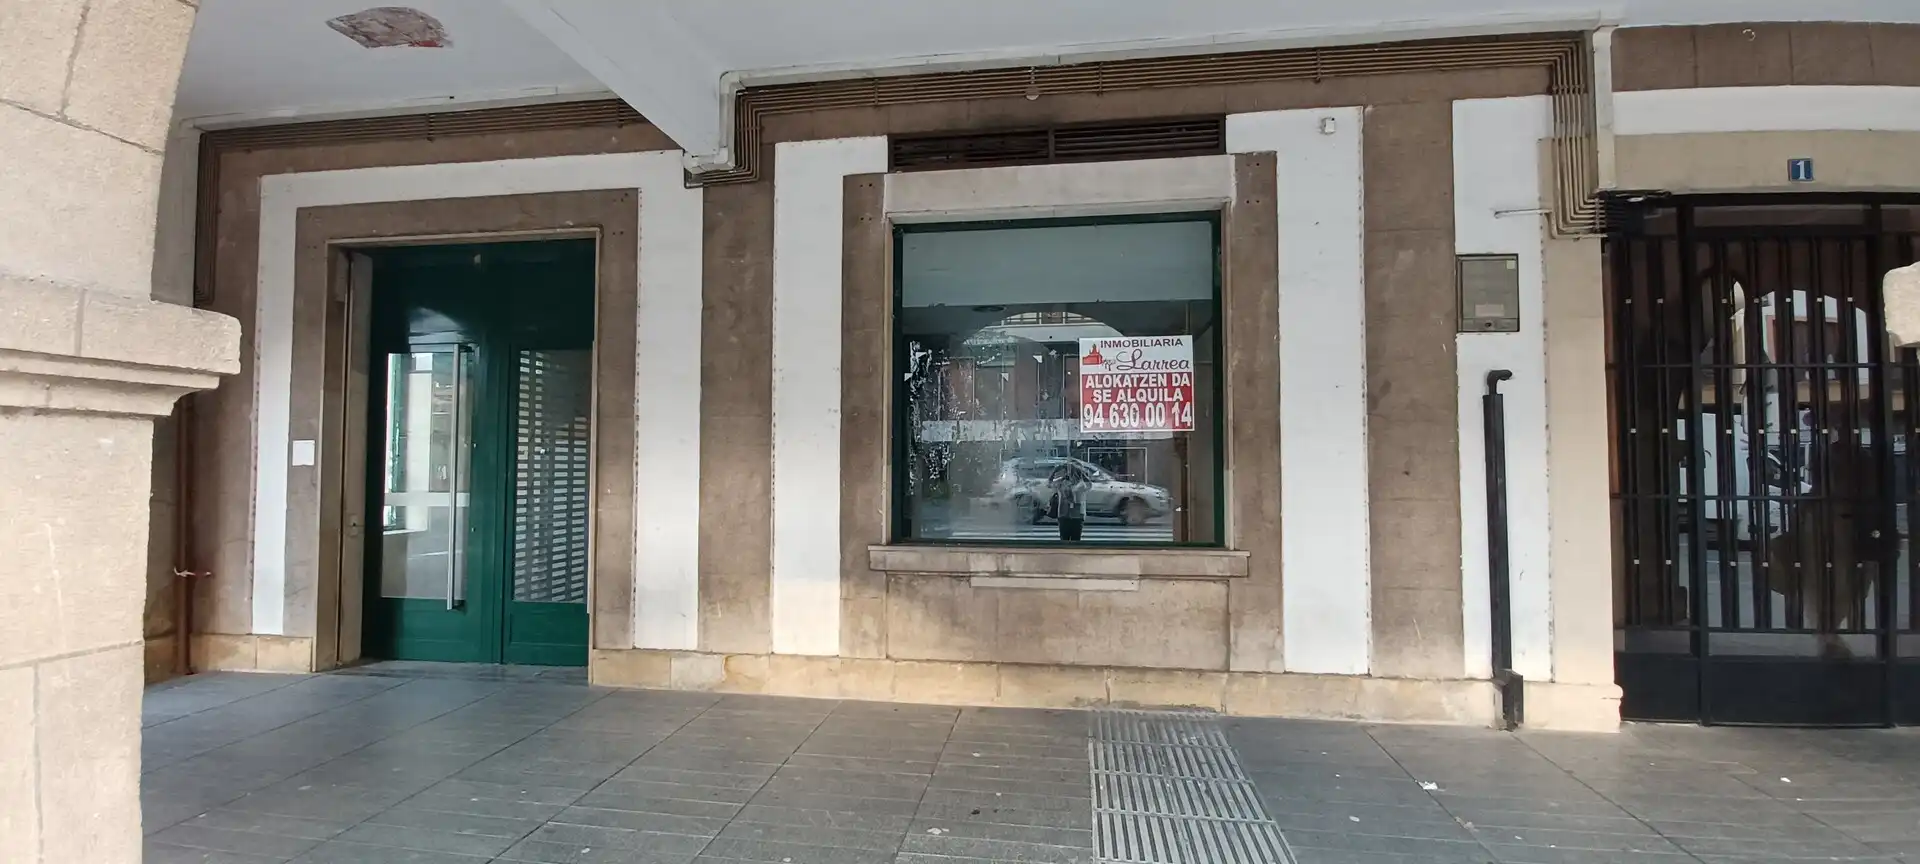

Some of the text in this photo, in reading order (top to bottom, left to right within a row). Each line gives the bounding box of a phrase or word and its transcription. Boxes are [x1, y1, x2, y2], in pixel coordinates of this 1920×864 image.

[1796, 160, 1806, 180] 1
[1100, 338, 1184, 348] INMOBILIARIA
[1115, 349, 1190, 371] Larrea
[1085, 373, 1191, 389] ALOKATZEN DA
[1092, 388, 1184, 403] SE ALQUILA
[1083, 402, 1192, 429] 94 630 00 14
